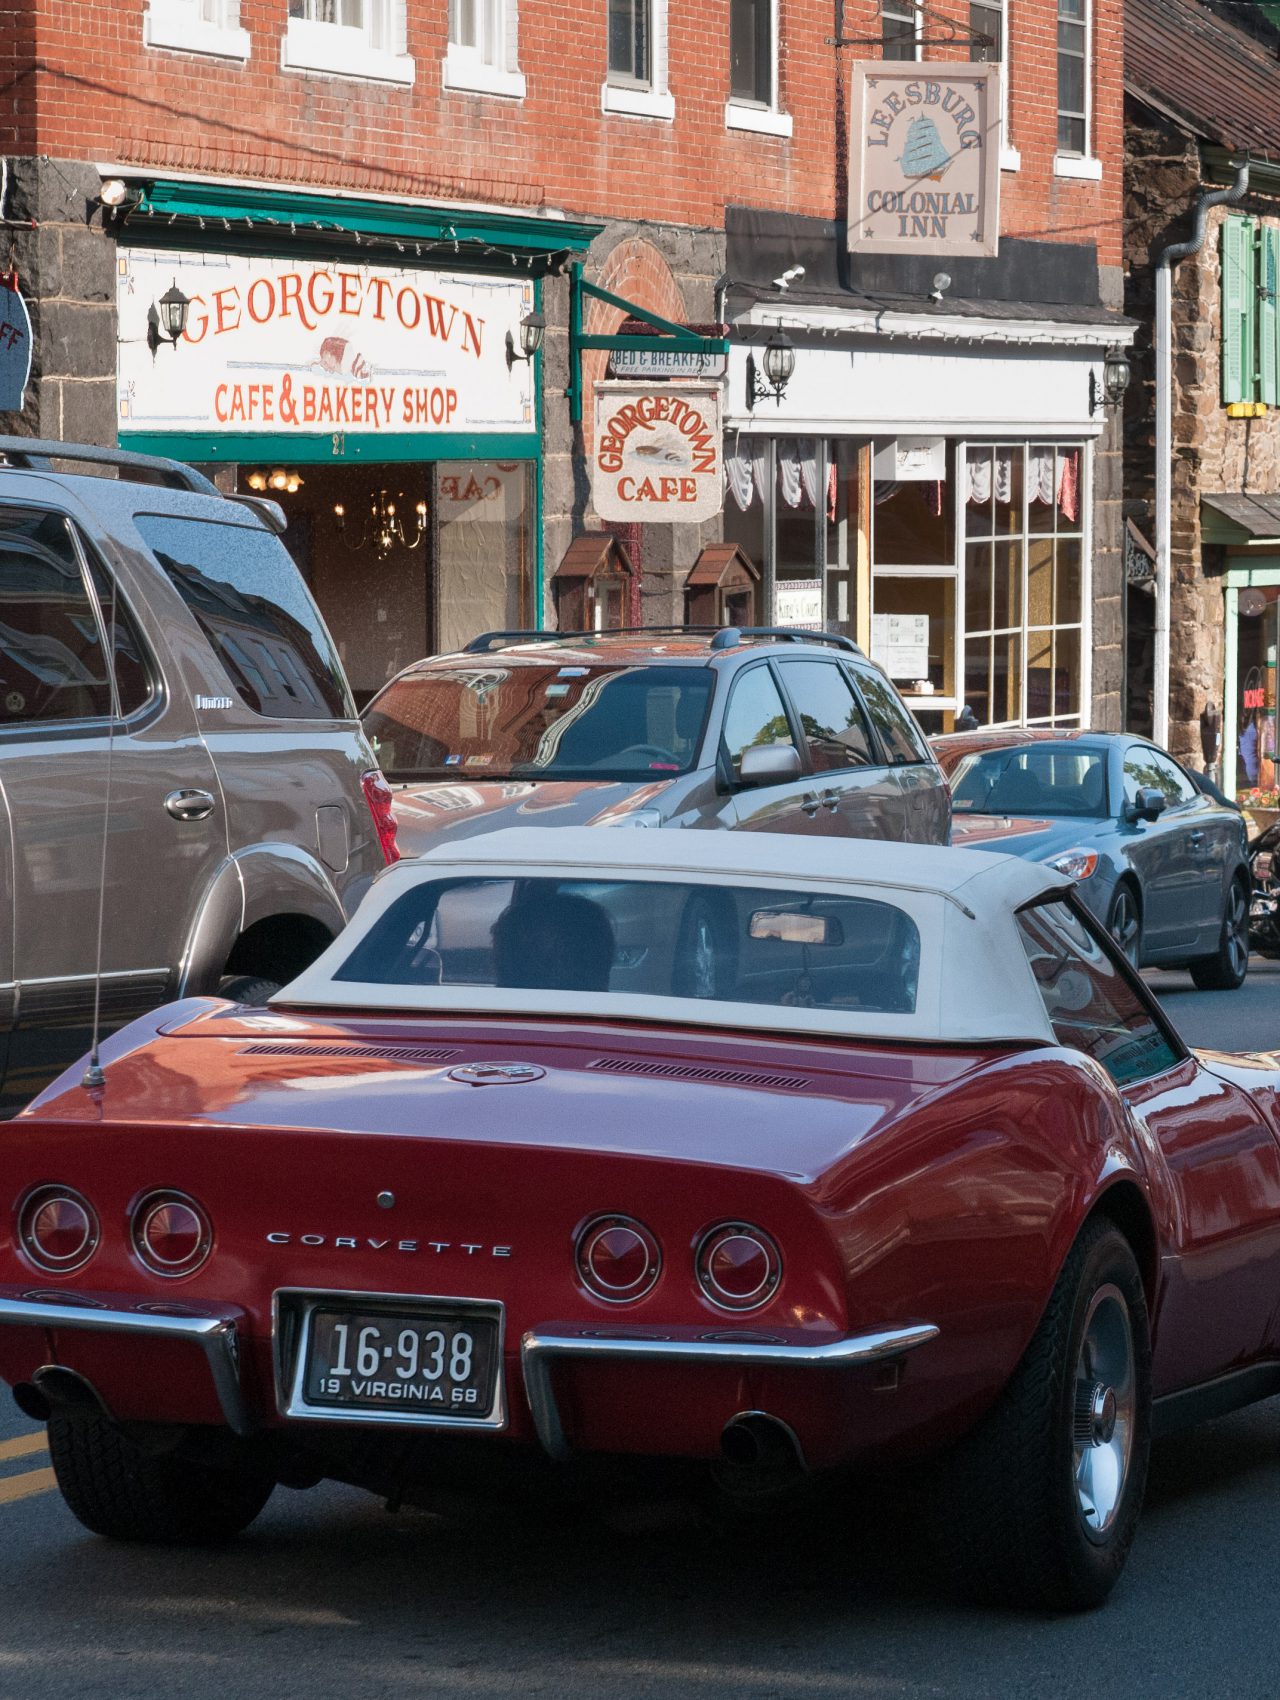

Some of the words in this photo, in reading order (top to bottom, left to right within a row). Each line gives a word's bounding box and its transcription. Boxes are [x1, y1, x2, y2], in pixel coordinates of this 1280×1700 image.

[868, 81, 982, 150] LEESBURG
[867, 190, 979, 214] COLONIAL
[898, 215, 948, 238] INN
[180, 271, 486, 358] GEORGETOWN
[615, 351, 636, 365] BED
[640, 351, 648, 366] &
[651, 352, 717, 367] BREAKFAST
[215, 383, 274, 422] CAFE
[279, 373, 300, 425] &
[303, 386, 395, 428] BAKERY
[403, 387, 457, 425] SHOP
[598, 396, 716, 475] GEORGETOWN
[617, 476, 698, 502] CAFE
[266, 1232, 512, 1257] CORVETTE
[320, 1378, 340, 1393] 19
[351, 1380, 444, 1401] VIRGINIA
[451, 1388, 477, 1403] 68
